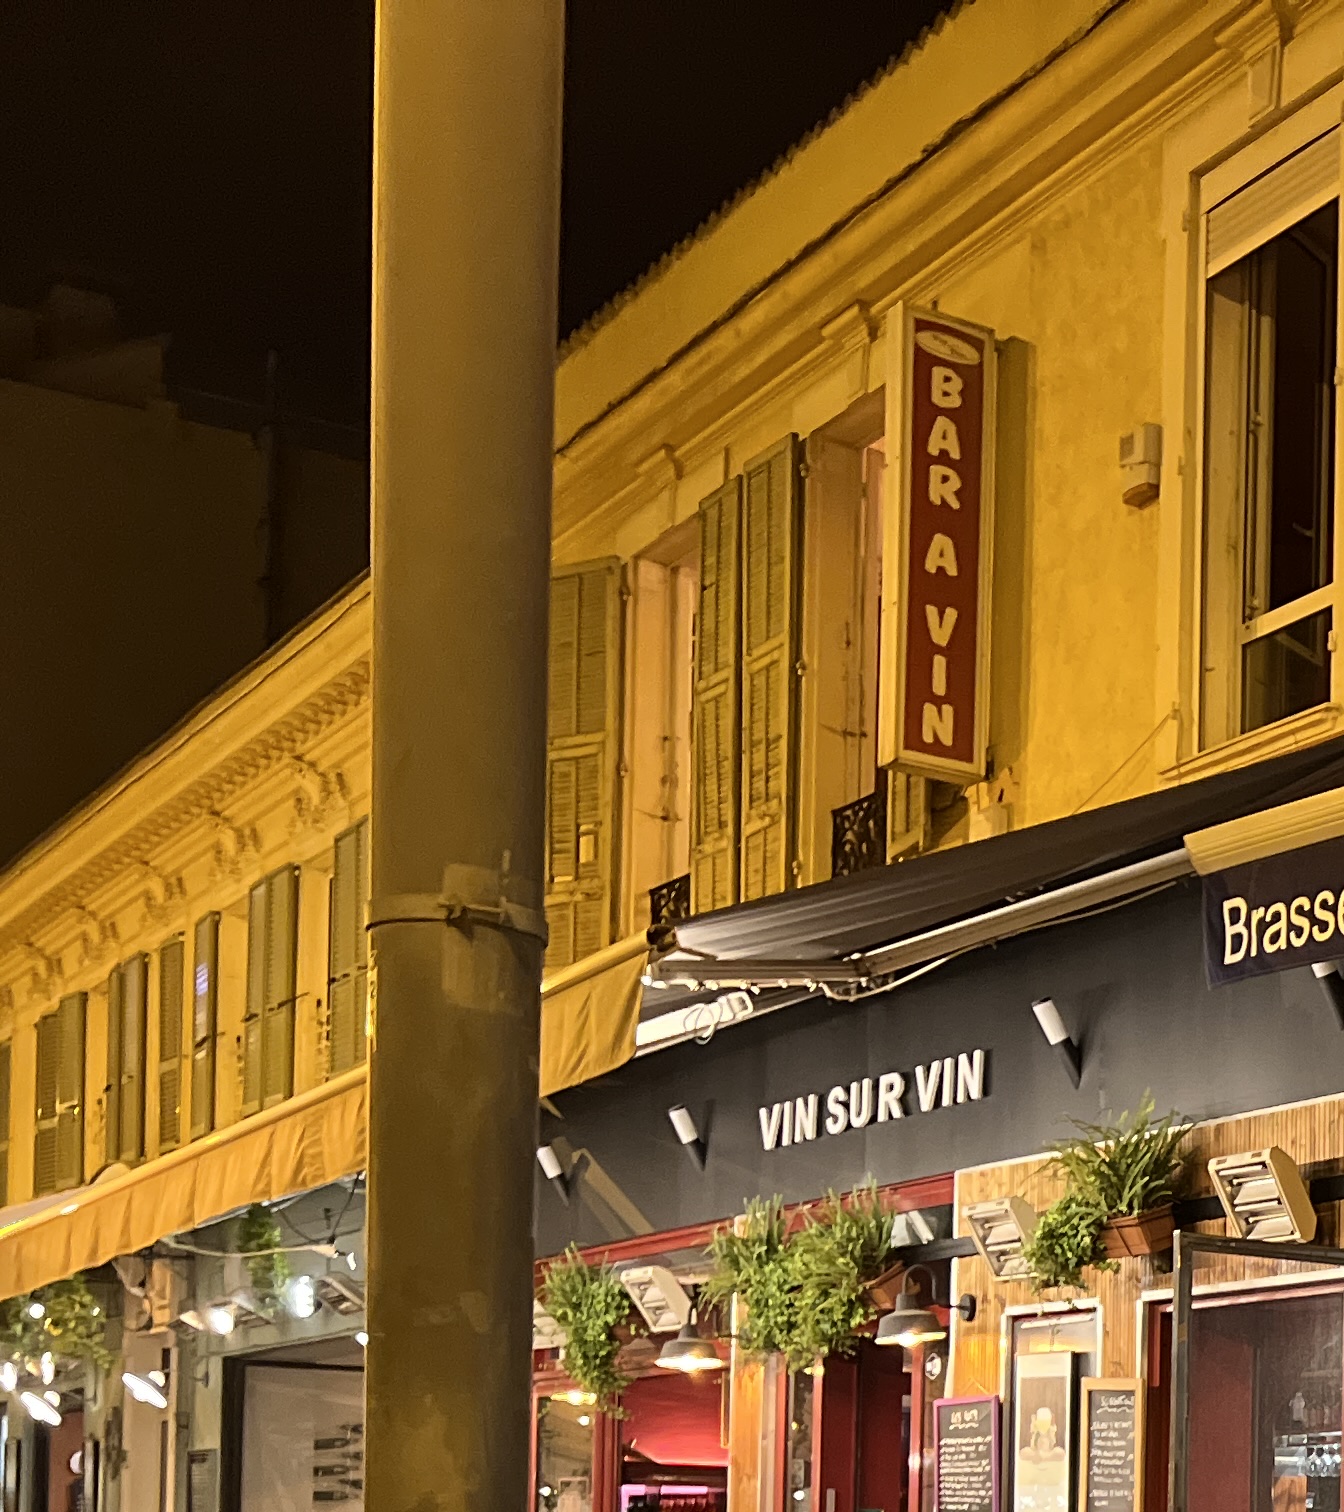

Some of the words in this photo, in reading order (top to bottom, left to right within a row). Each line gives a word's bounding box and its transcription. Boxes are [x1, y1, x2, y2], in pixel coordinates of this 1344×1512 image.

[926, 365, 964, 511] BAR
[924, 532, 959, 577] A
[921, 603, 958, 747] VIN
[759, 1093, 818, 1151] VIN
[825, 1071, 906, 1136] SUR
[915, 1049, 986, 1112] VIN
